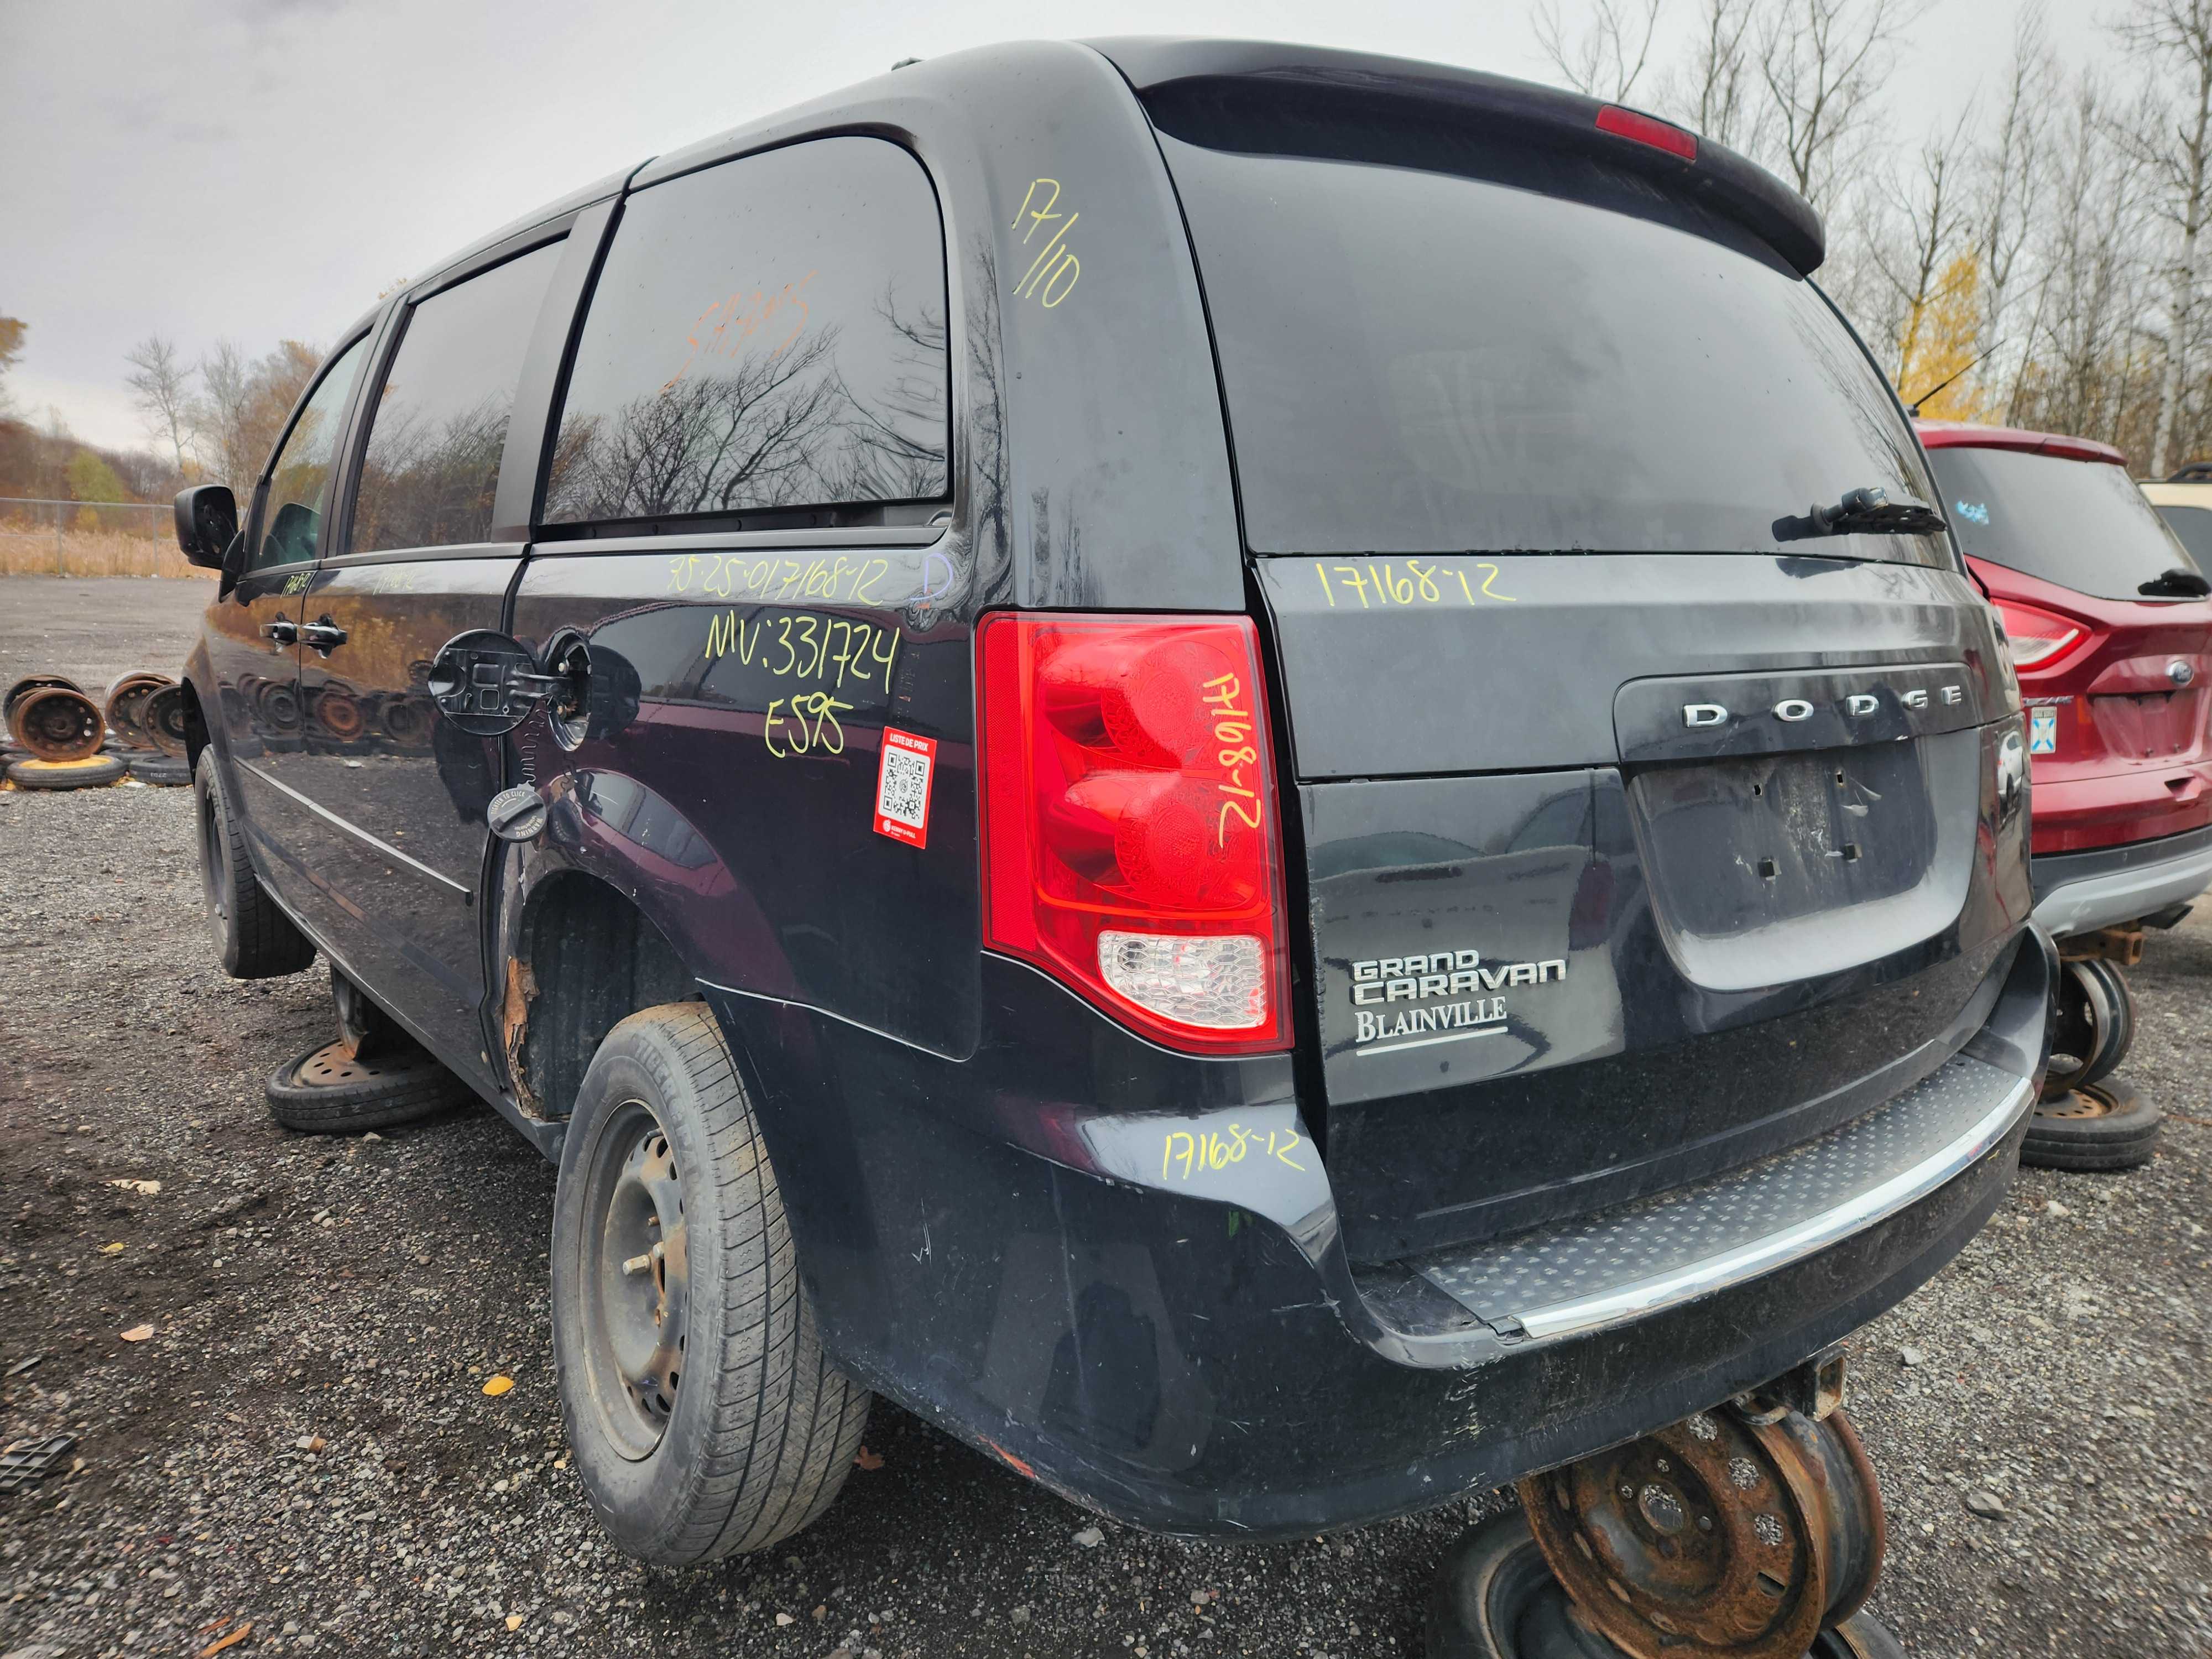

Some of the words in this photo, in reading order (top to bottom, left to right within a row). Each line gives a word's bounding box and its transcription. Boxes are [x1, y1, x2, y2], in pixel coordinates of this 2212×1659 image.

[1316, 560, 1517, 608] 17168-12
[1682, 685, 1962, 728] DODGE
[889, 733, 906, 745] LISTE
[905, 737, 914, 748] DE
[914, 739, 929, 752] PRIX
[1202, 672, 1261, 849] 17168-12
[515, 817, 544, 837] WARNING
[1351, 950, 1479, 982] GRAND
[1351, 959, 1566, 1006] CARAVAN
[1163, 1124, 1306, 1180] 17168-12
